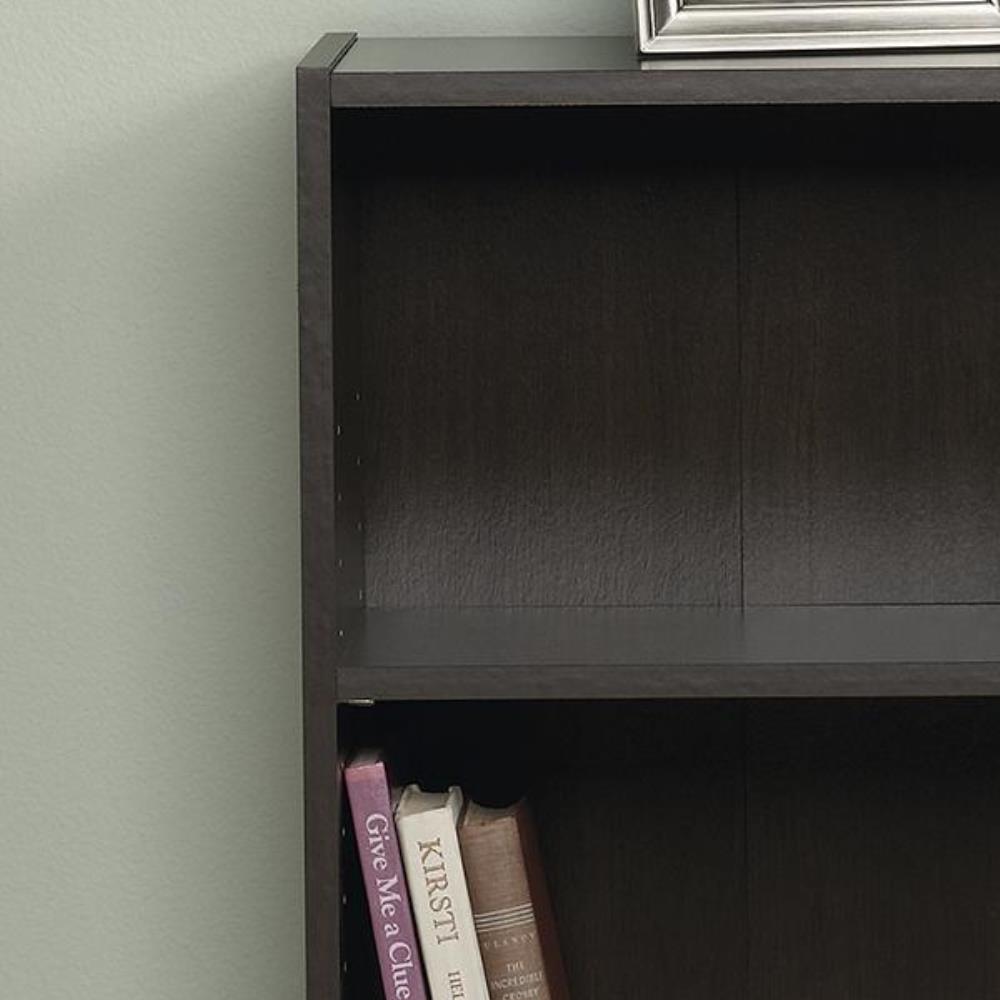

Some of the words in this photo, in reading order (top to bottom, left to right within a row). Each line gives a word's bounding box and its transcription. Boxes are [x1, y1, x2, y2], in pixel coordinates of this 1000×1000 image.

[365, 813, 390, 872] Give
[375, 876, 402, 919] Me
[416, 837, 459, 945] KIRSTI
[384, 923, 401, 938] a
[389, 942, 414, 1000] Clue
